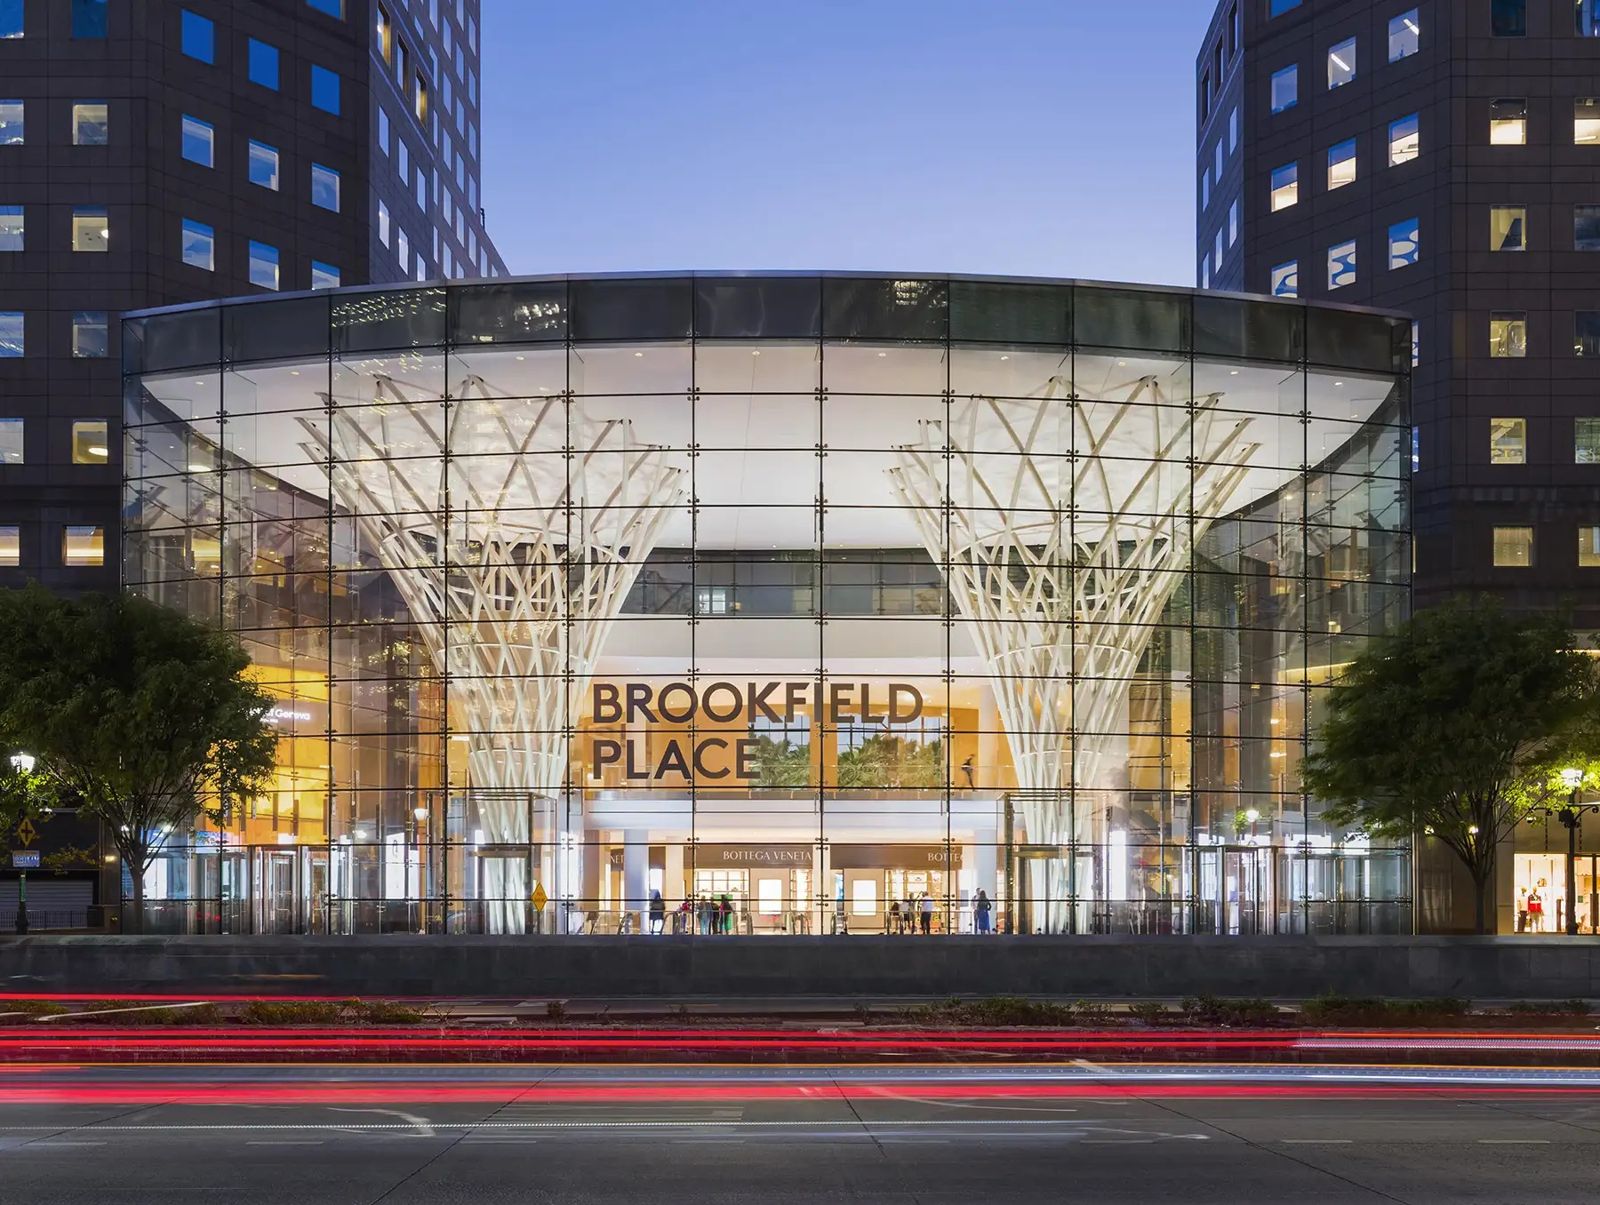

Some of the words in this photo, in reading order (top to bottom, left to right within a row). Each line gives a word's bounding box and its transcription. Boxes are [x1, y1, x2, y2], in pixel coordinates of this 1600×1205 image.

[593, 682, 923, 724] BROOKFIELD
[593, 738, 761, 780] PLACE
[723, 850, 771, 861] BOTTEGA
[773, 850, 812, 861] VENETA
